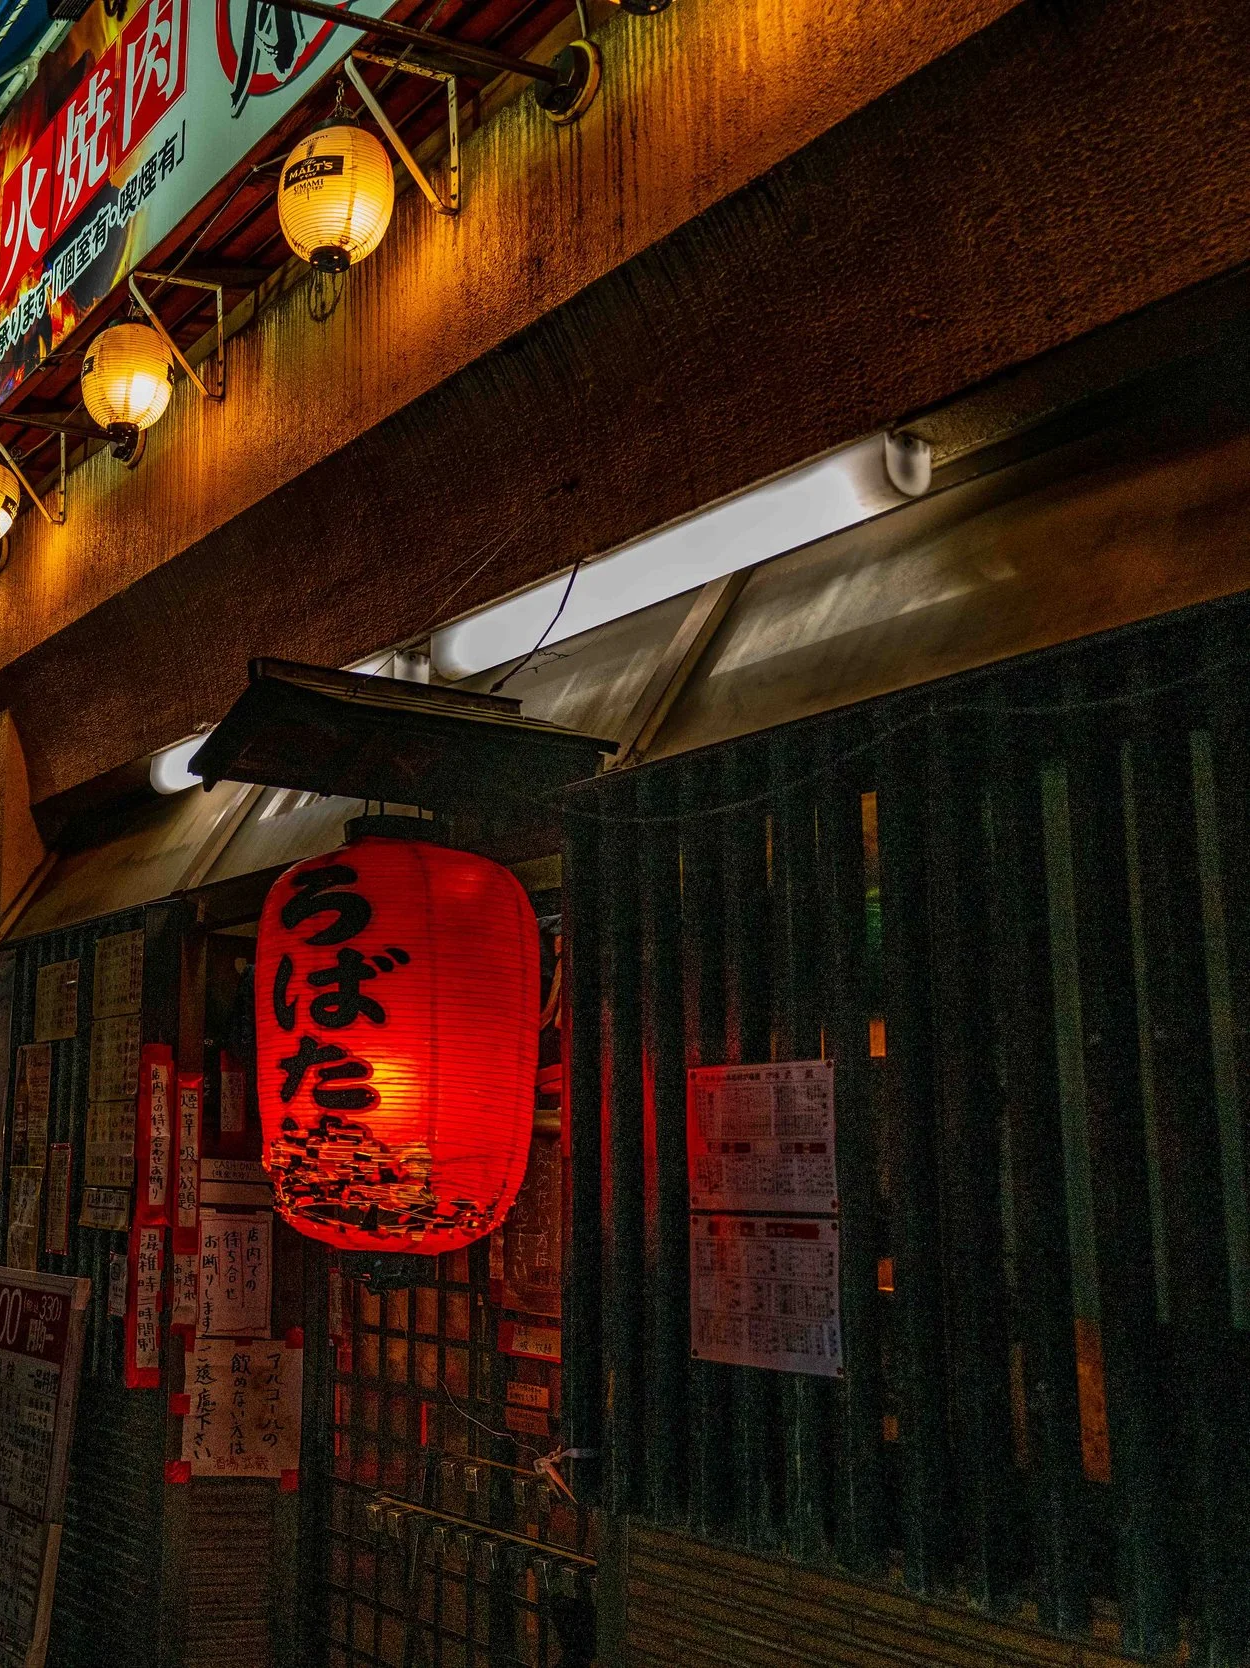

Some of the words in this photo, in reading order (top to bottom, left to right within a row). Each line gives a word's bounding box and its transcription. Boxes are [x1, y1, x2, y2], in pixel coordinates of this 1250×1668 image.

[288, 160, 334, 182] MALT'S
[273, 863, 411, 1185] ろばた
[202, 1235, 219, 1334] お断りします
[245, 1227, 262, 1292] 店内での
[194, 1345, 217, 1460] ご遠慮下さい
[230, 1352, 251, 1455] 飲めない方は
[256, 1353, 284, 1448] アルコールの
